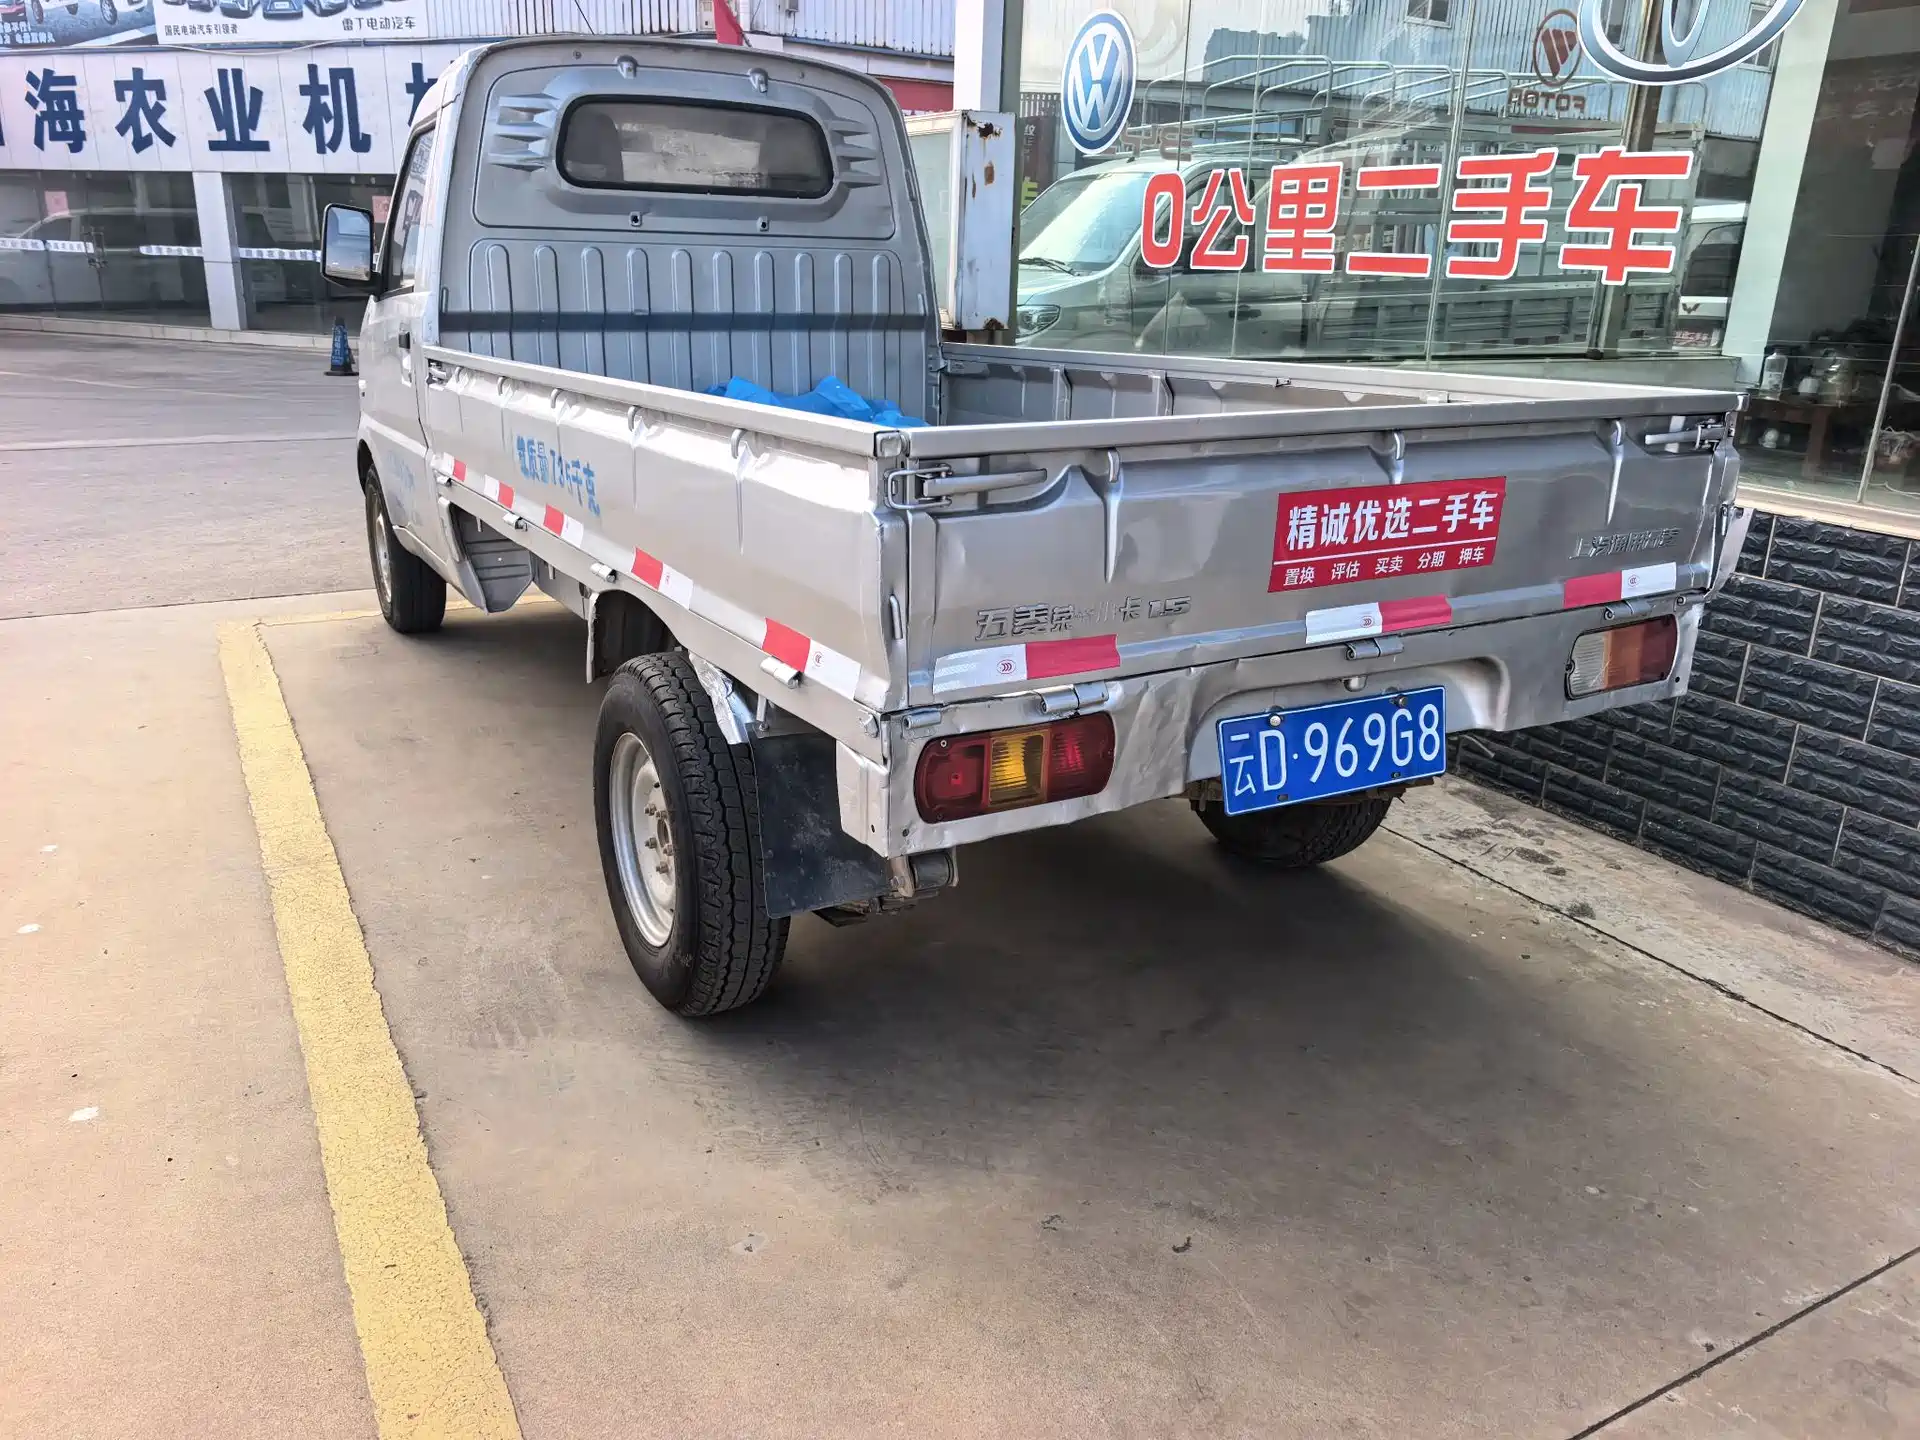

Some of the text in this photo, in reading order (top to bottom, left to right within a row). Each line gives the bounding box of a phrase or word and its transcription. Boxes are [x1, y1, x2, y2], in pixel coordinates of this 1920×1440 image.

[164, 23, 239, 36] 国民电动汽车引领者
[342, 16, 417, 31] 雷丁电动汽车
[0, 61, 436, 154] 海农业机
[1140, 146, 1693, 286] 0公里二手车
[1286, 490, 1498, 551] 精诚优选二手车
[1283, 546, 1486, 586] 置换 评估 买卖 分期 押车
[1229, 703, 1441, 797] 云D·969G8
